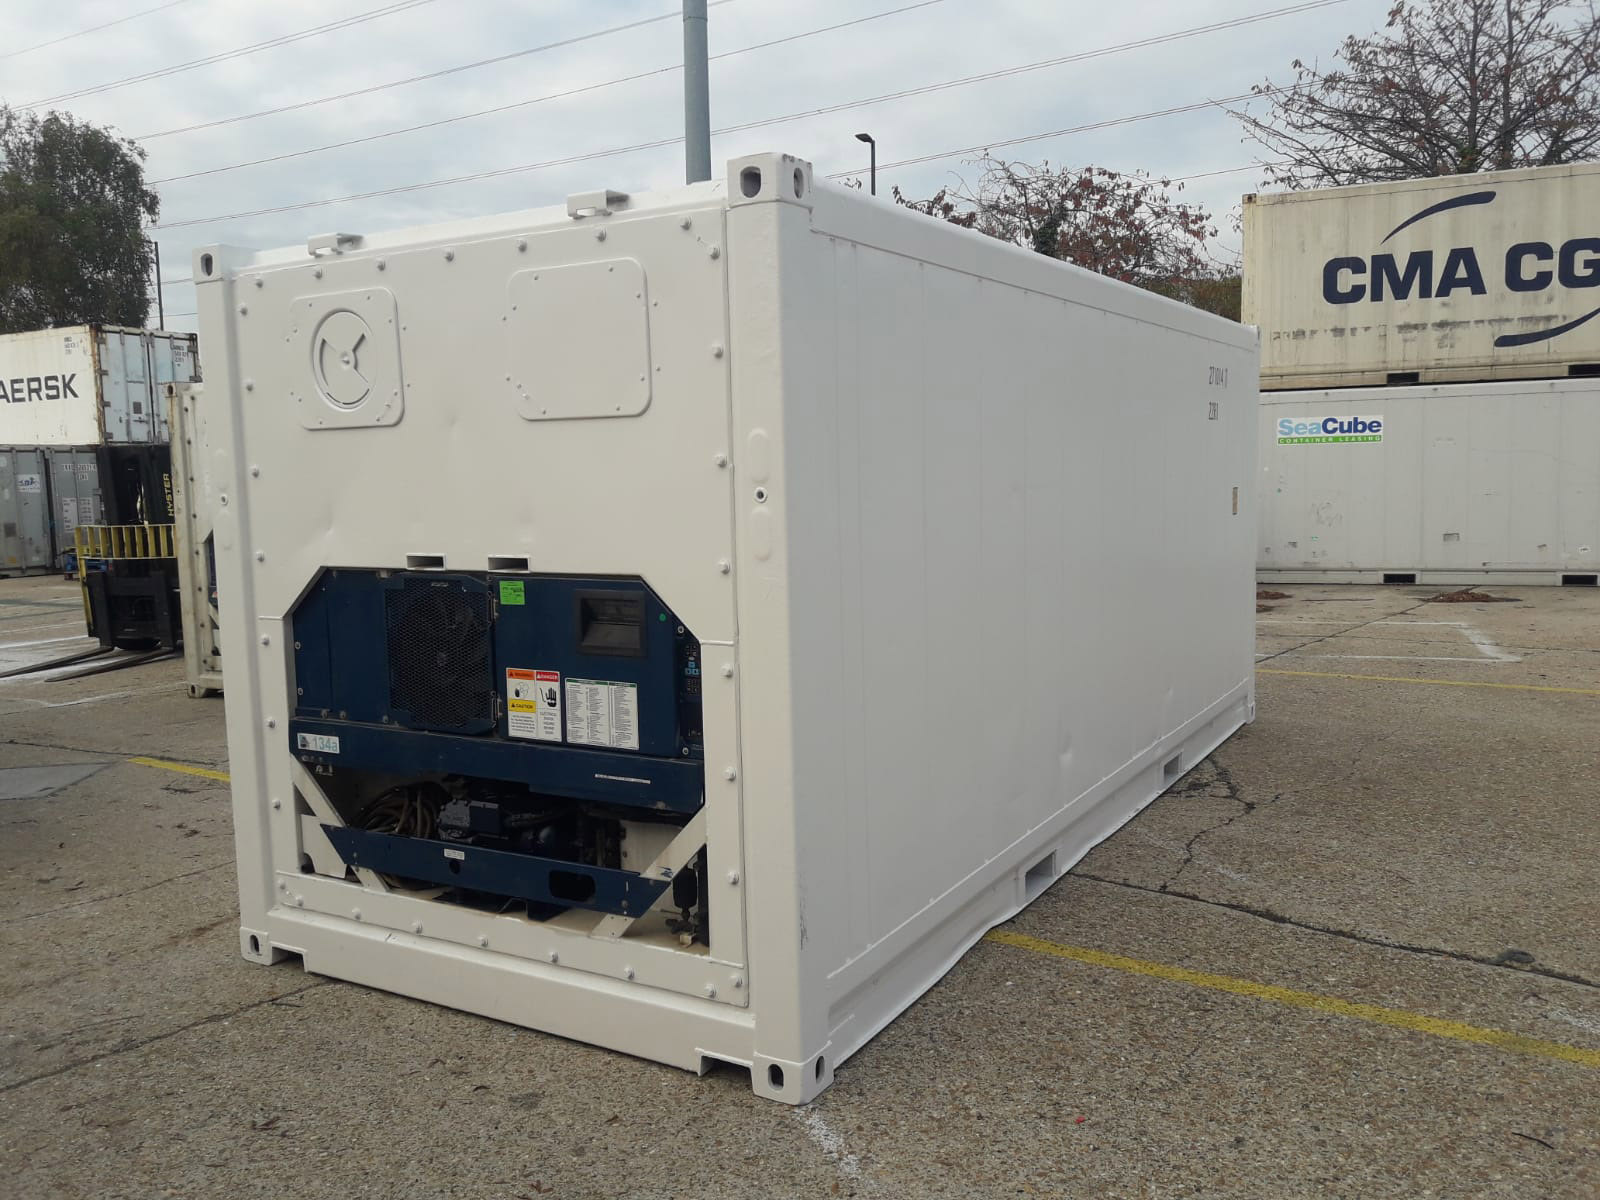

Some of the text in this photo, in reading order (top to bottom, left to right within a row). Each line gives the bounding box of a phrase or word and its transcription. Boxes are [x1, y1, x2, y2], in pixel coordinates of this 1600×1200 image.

[1323, 238, 1600, 304] CMA CG
[1278, 416, 1382, 435] SeaCube
[1279, 436, 1334, 444] CONTAINER
[163, 473, 174, 516] HYSTER
